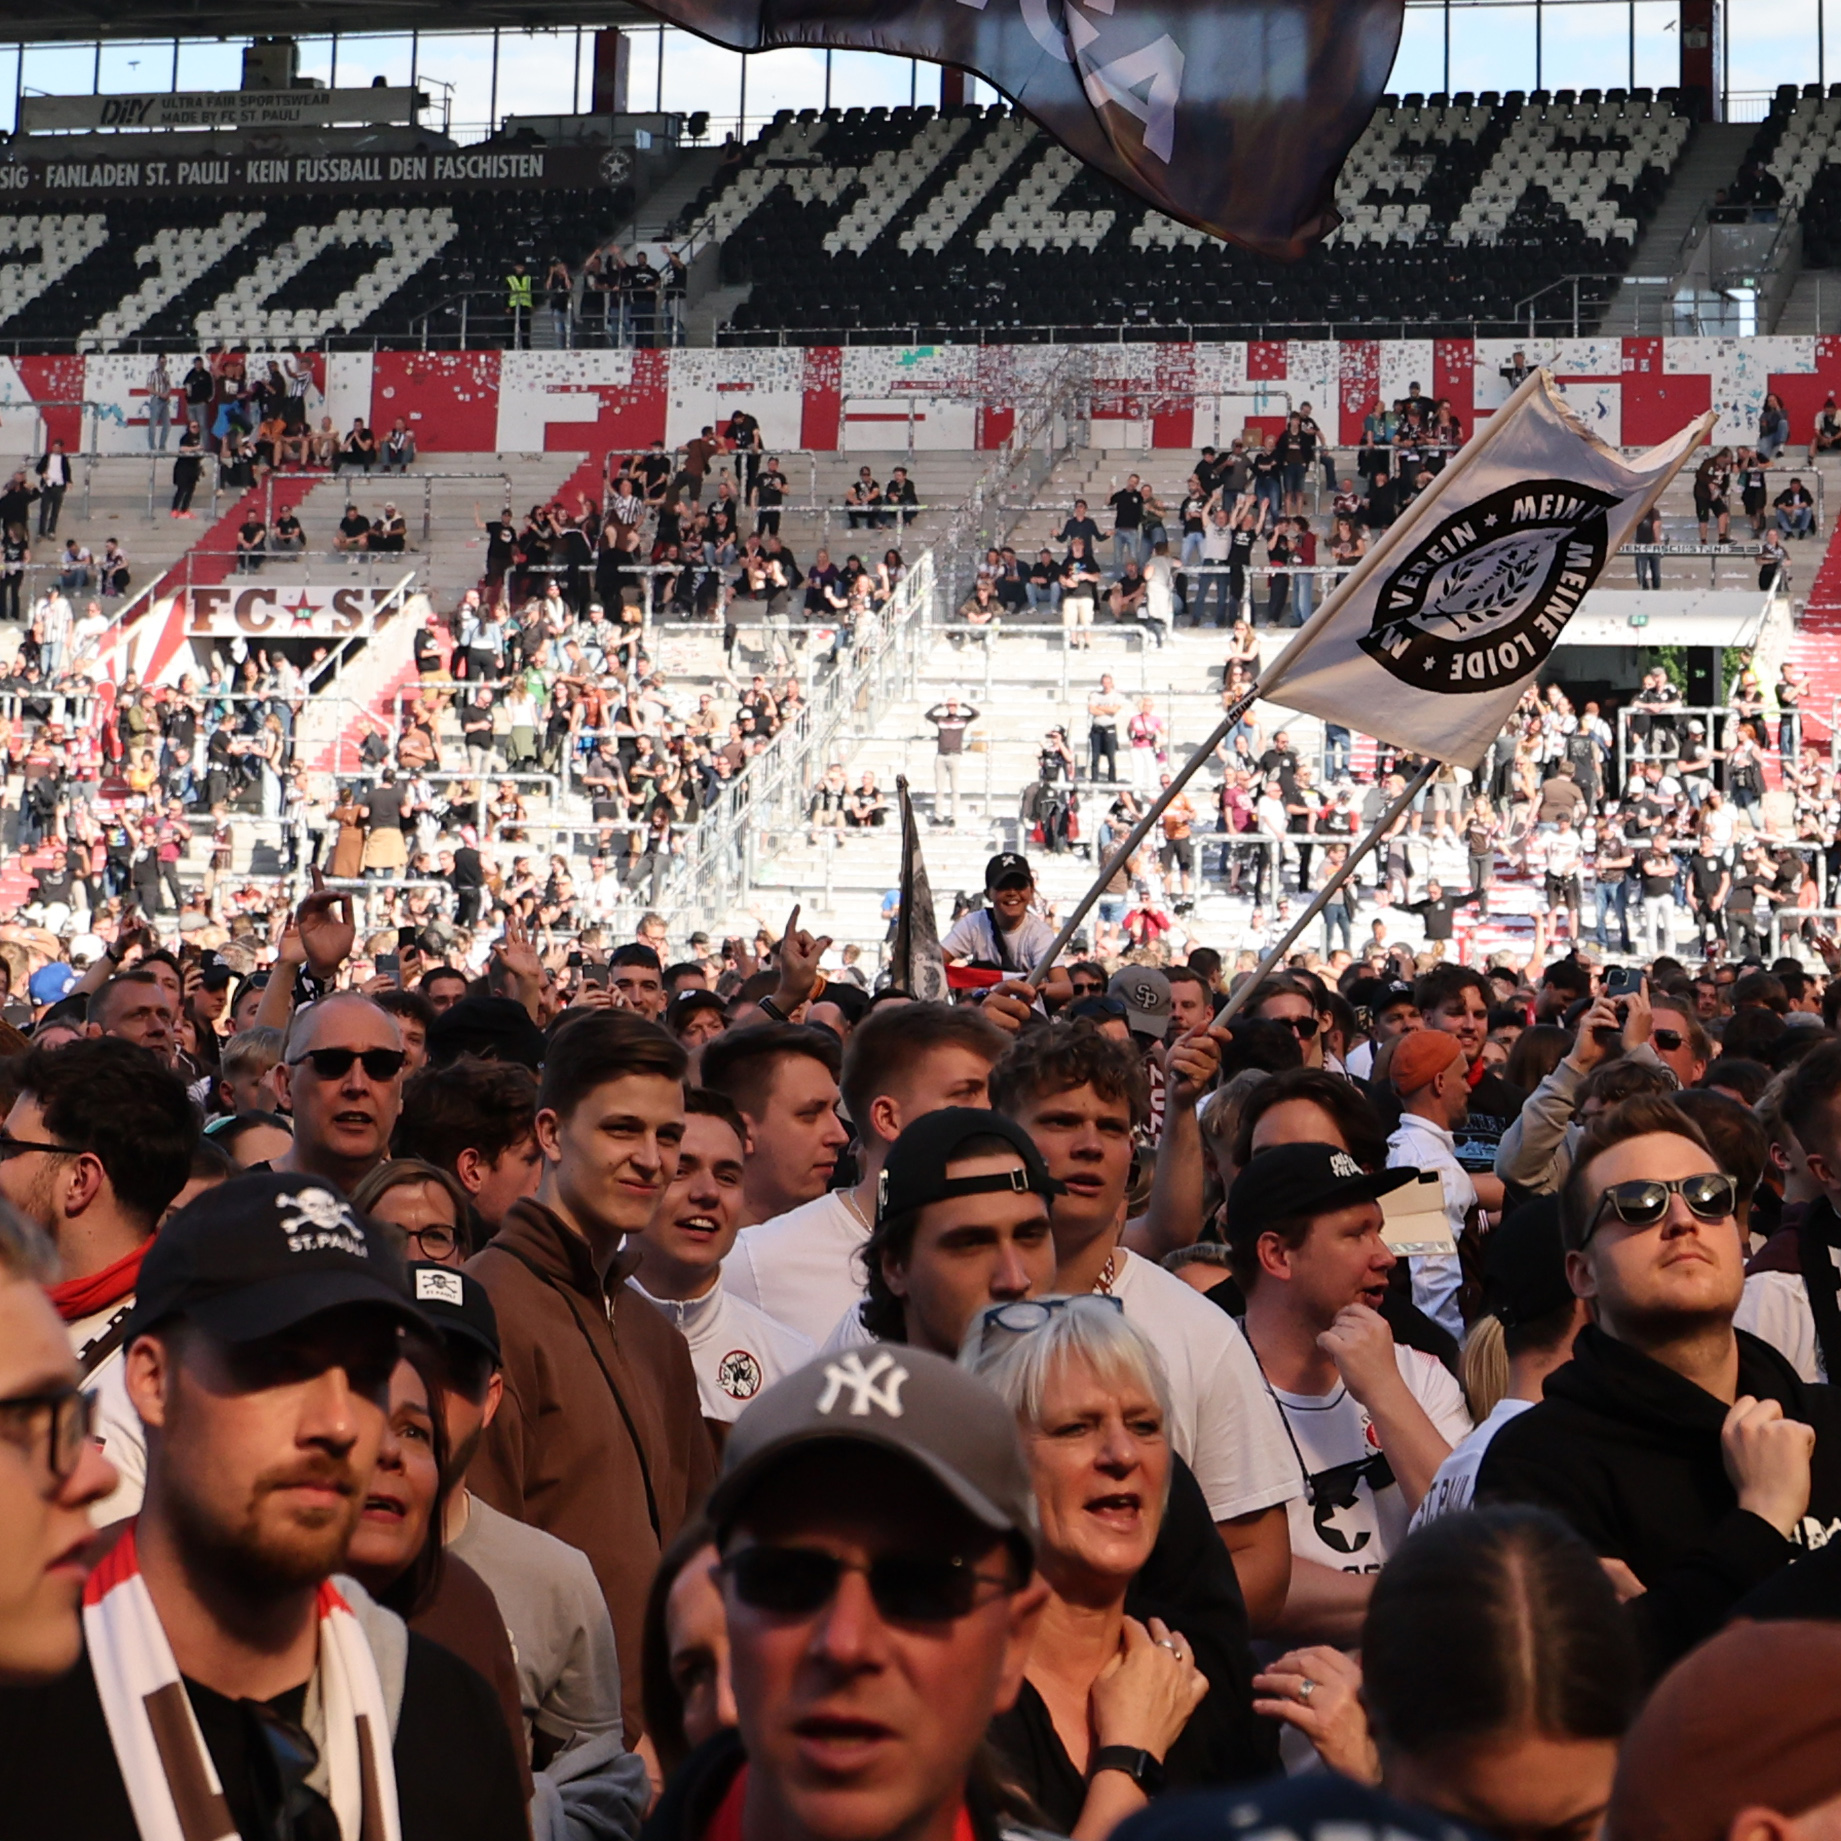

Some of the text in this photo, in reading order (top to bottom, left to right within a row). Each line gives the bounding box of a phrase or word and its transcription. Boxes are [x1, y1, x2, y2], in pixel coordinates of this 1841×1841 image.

[161, 93, 331, 109] ULTRA FAIR SPORTSWEAR
[161, 112, 198, 124] MADE
[202, 111, 218, 123] BY
[262, 109, 301, 122] PAULI
[45, 163, 139, 188] FANLADEN
[145, 163, 171, 187] ST.
[177, 161, 229, 186] PAULI
[246, 160, 289, 184] KEIN
[295, 157, 382, 183] FUSSBALL
[388, 156, 427, 181] DEN
[433, 154, 544, 180] FASCHISTEN
[1388, 520, 1478, 610] VEREIN
[189, 587, 278, 632] FC
[1533, 541, 1594, 641] MEINE
[1449, 631, 1537, 681] LOIDE
[1135, 983, 1158, 1010] SP
[816, 1349, 910, 1418] NY
